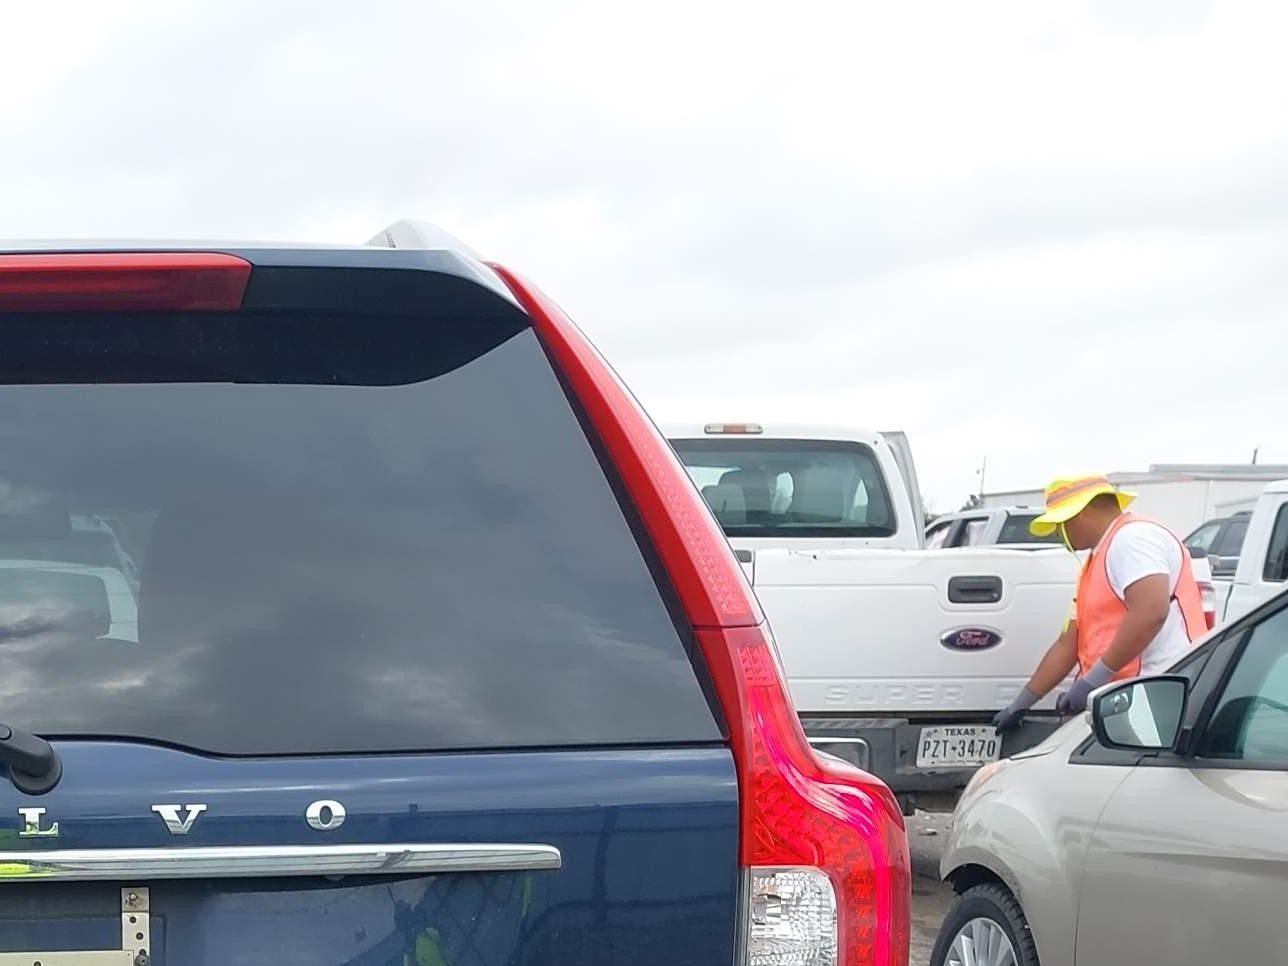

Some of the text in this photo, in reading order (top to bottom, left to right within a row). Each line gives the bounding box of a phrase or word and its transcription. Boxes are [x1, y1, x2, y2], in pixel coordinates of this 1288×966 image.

[956, 631, 991, 646] Ford
[824, 684, 964, 705] SUPER
[944, 728, 977, 737] TEXAS
